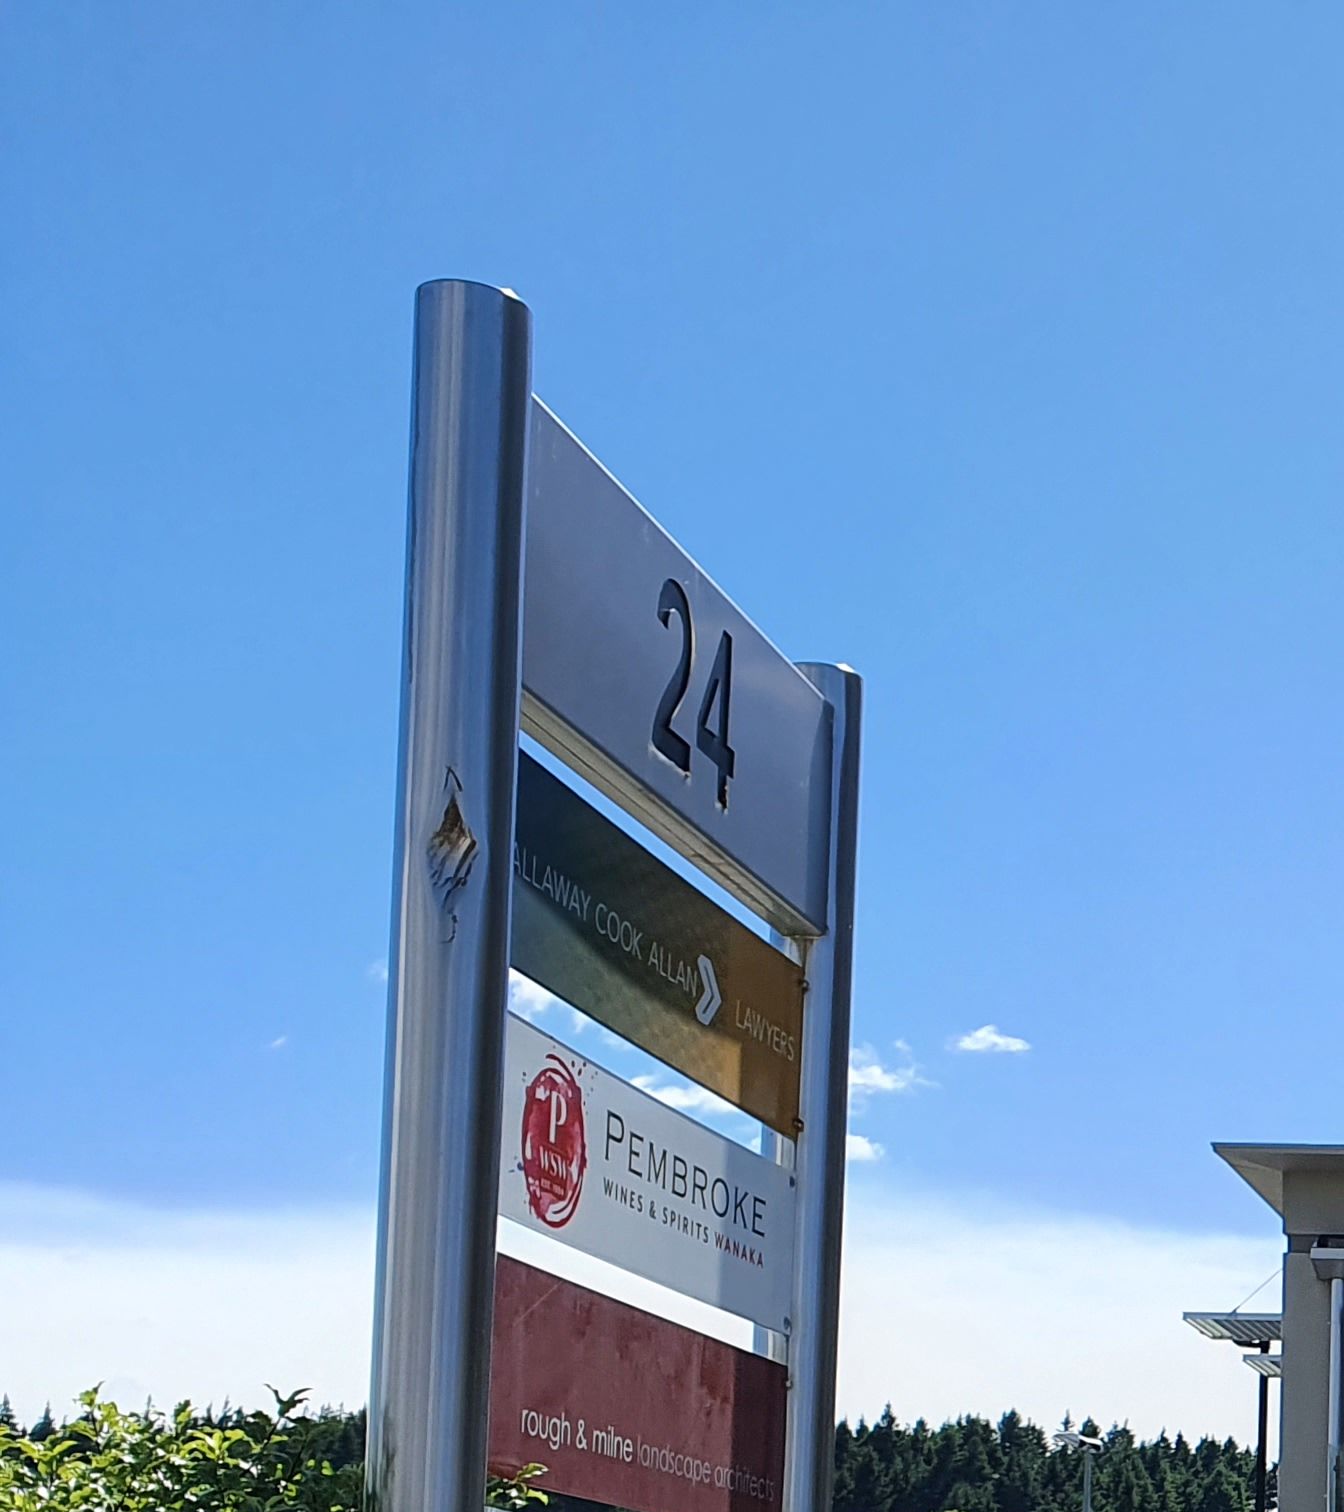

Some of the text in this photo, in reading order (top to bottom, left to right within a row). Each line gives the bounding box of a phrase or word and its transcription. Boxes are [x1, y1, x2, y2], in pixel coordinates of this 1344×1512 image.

[657, 578, 735, 811] 24
[595, 902, 643, 960] COOK
[648, 941, 698, 998] ALLAN
[735, 1001, 795, 1061] LAWYERS
[603, 1177, 643, 1213] WINES
[649, 1200, 657, 1221] &
[662, 1206, 709, 1244] SPIRITS
[714, 1231, 764, 1268] WANAKA
[604, 1109, 767, 1237] PEMBROKE
[521, 1408, 775, 1501] rough & milne landscape architects
